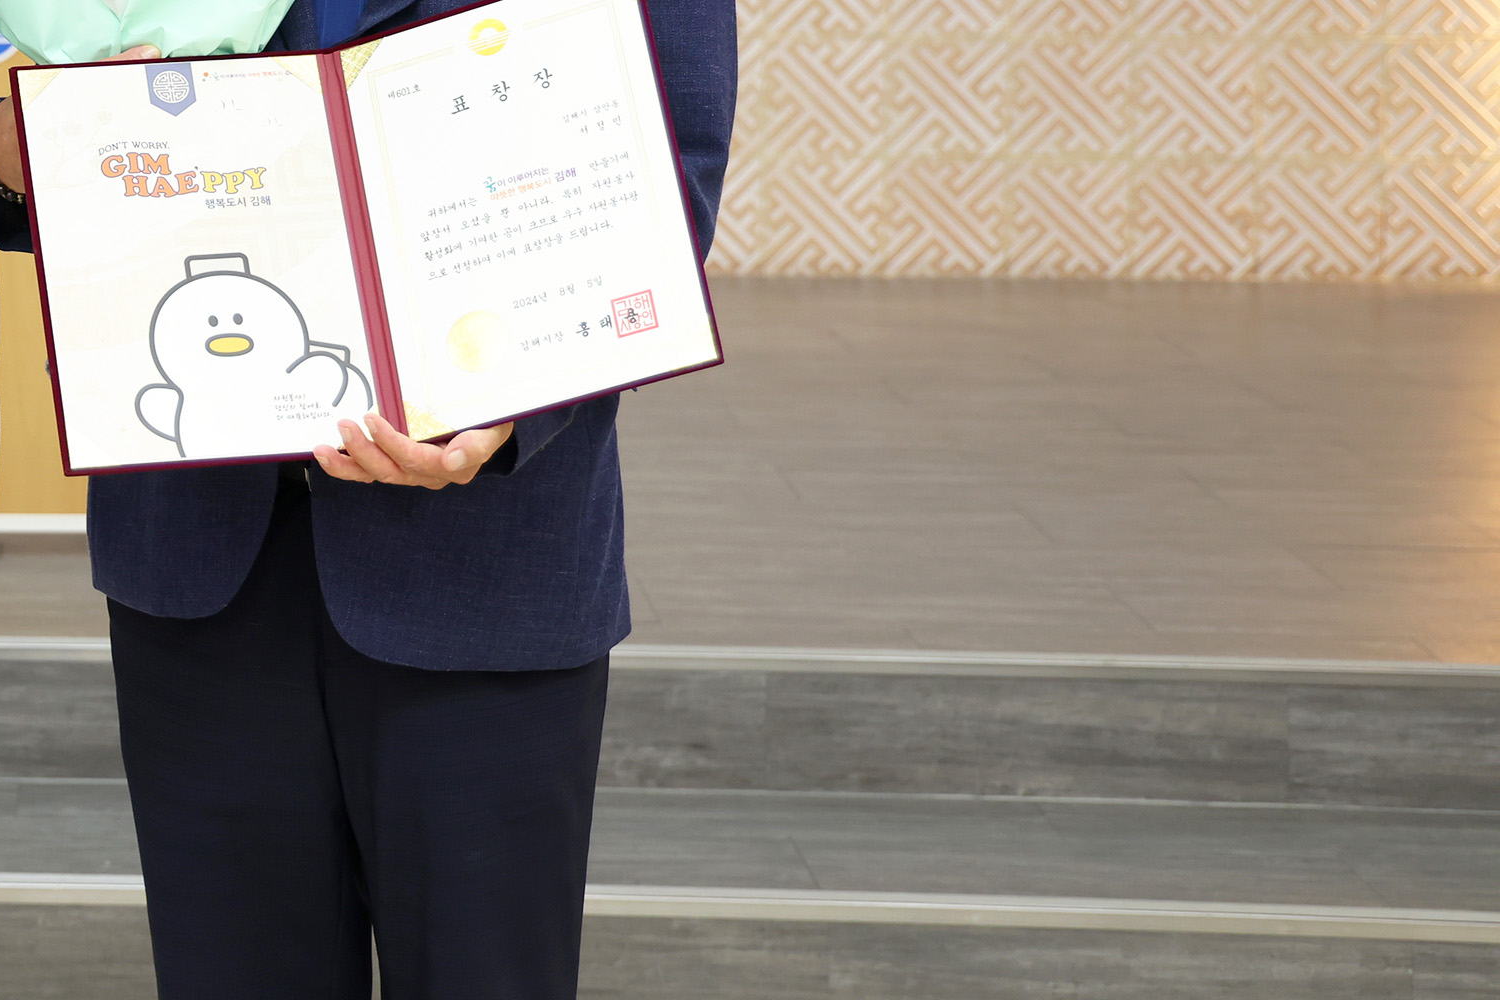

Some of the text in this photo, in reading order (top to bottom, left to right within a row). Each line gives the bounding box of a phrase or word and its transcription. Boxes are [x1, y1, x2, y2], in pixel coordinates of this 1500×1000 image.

[562, 109, 587, 123] 김해시
[98, 141, 128, 156] DON'T
[589, 151, 629, 172] 만들기에
[100, 152, 172, 178] GIM
[483, 167, 549, 193] 꿈이 이루어지는
[489, 166, 577, 201] 따뜻한 행복도시 김해
[205, 195, 272, 209] 행복도시 김해
[419, 224, 451, 243] 앞장서
[592, 170, 635, 189] 자원봉사
[468, 231, 498, 247] 기여한
[503, 224, 522, 239] 공이
[528, 214, 559, 232] 크므로
[563, 206, 583, 219] 우수
[428, 219, 614, 281] 으로 선정하여 이에 표창장을 드립니다.
[512, 275, 603, 309] 2024년 8월 5일
[520, 330, 564, 352] 김해시장
